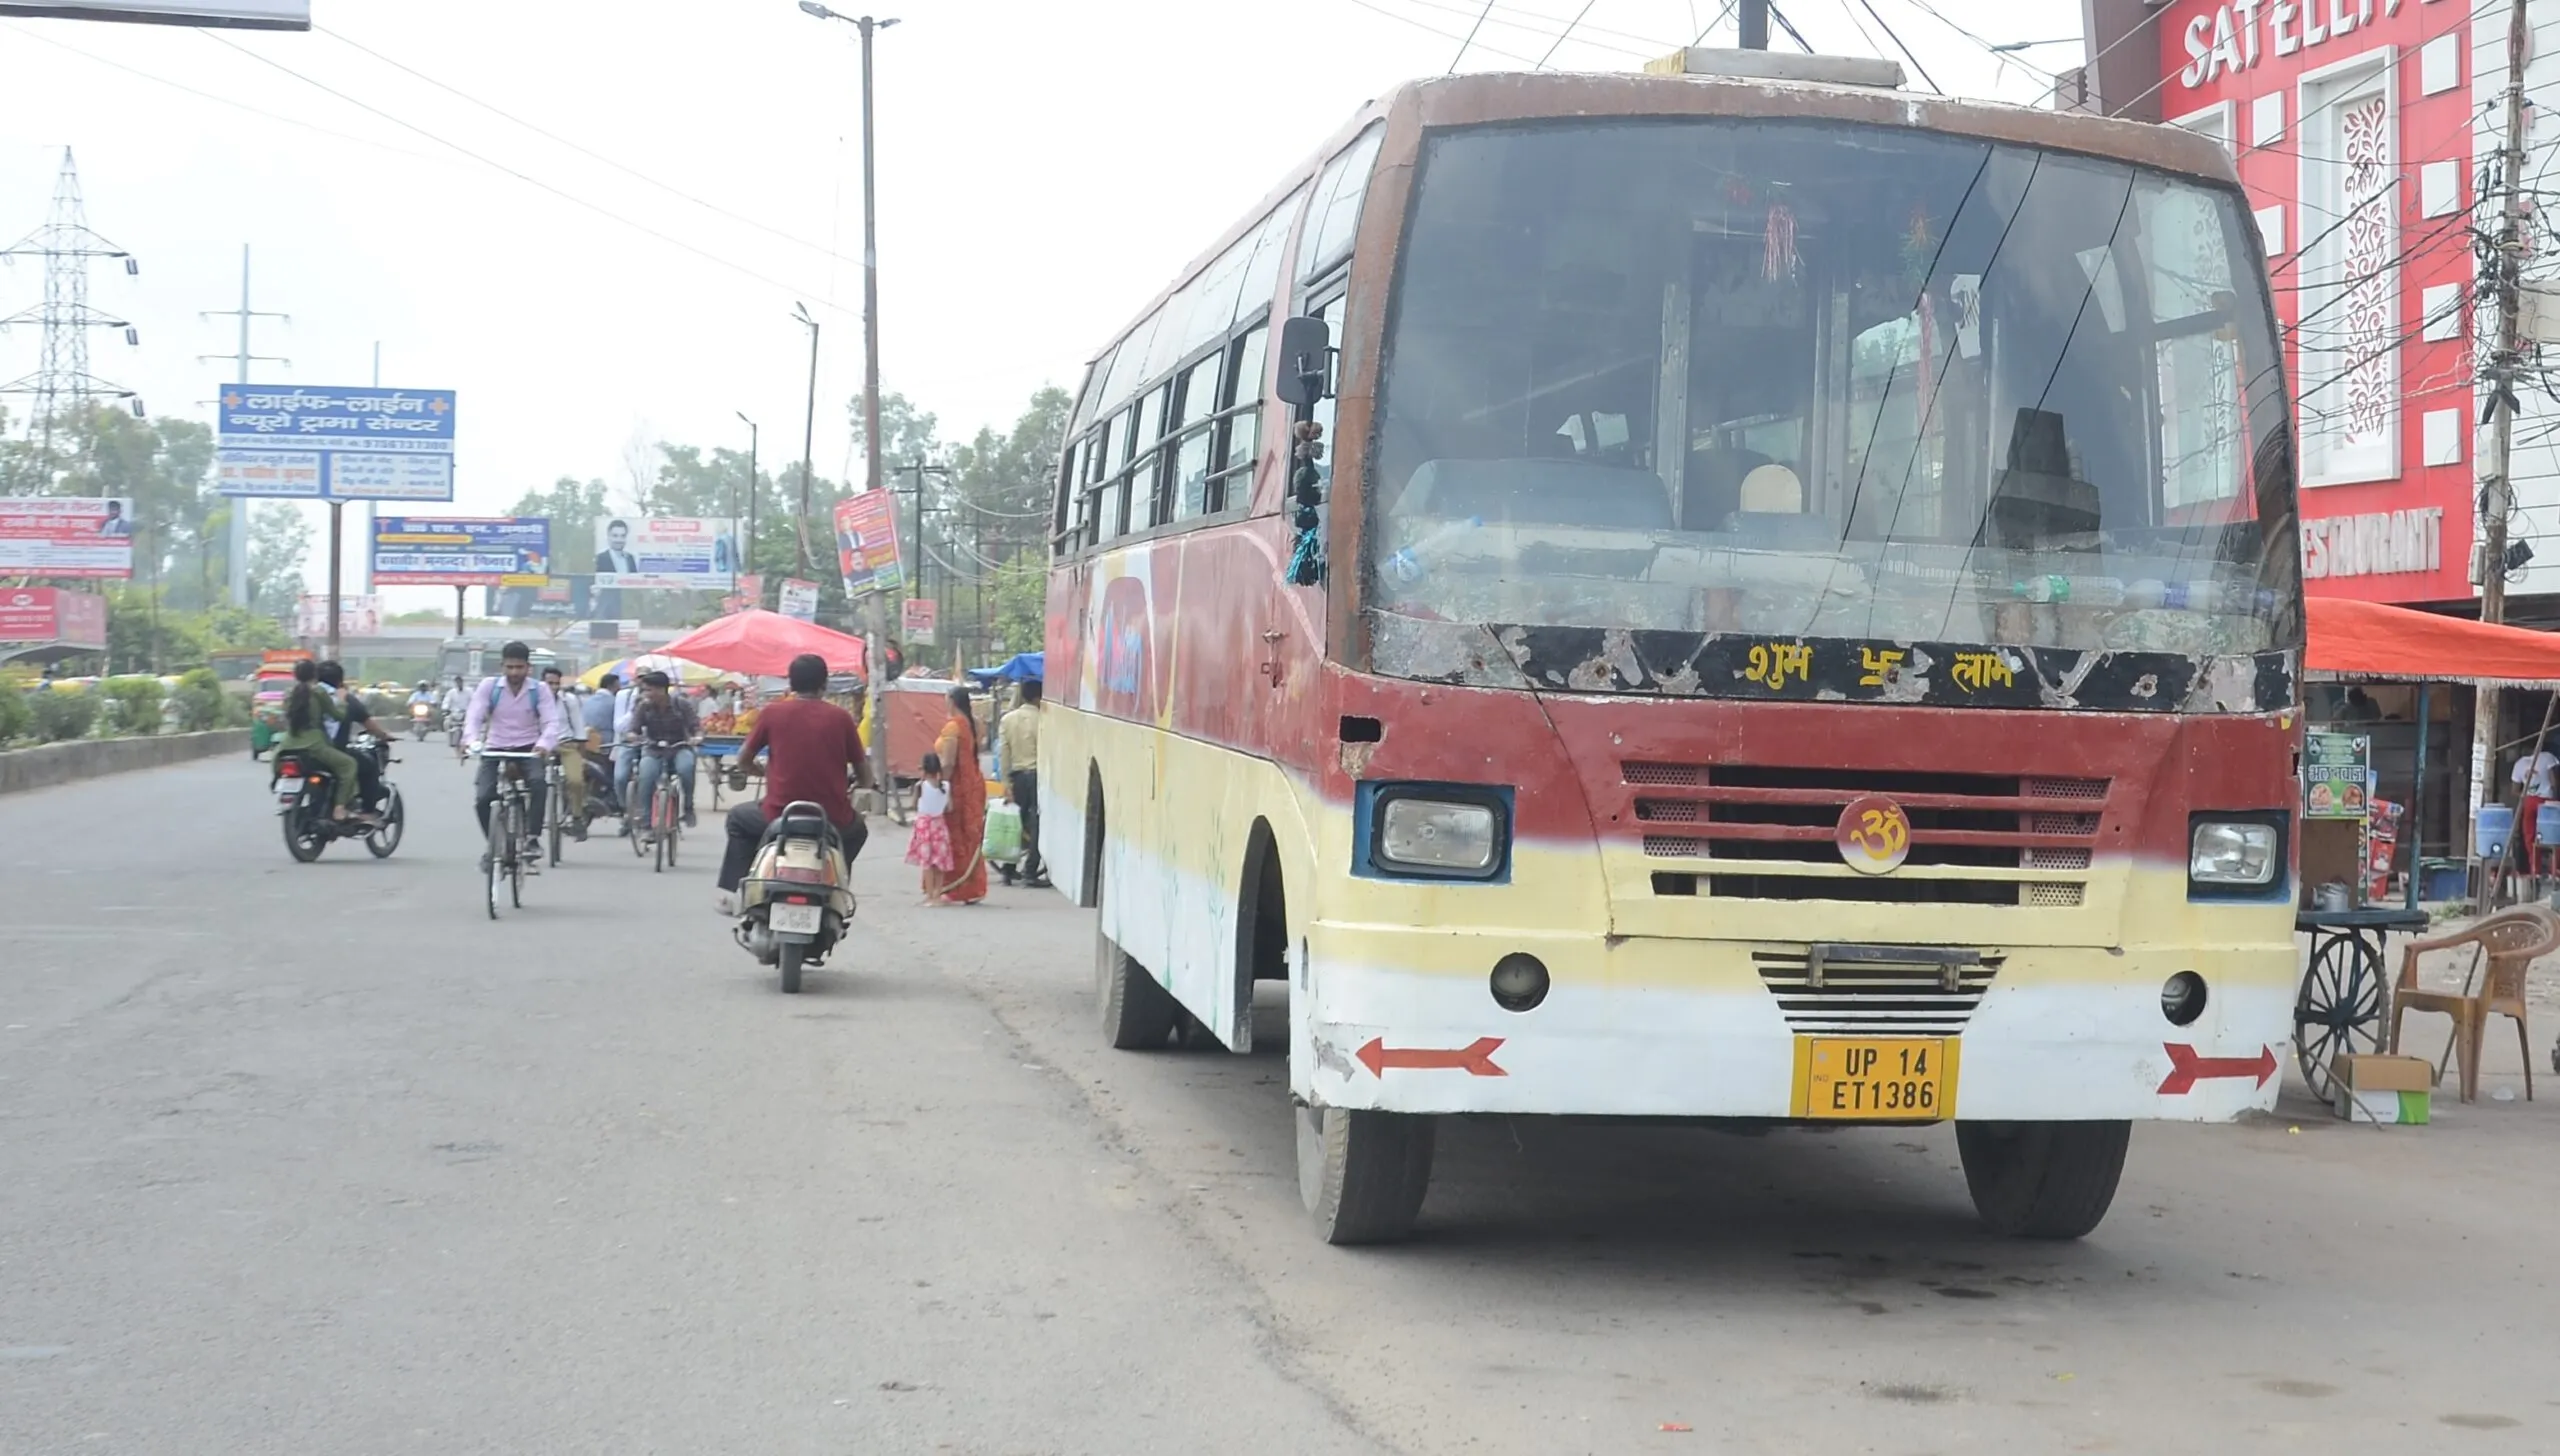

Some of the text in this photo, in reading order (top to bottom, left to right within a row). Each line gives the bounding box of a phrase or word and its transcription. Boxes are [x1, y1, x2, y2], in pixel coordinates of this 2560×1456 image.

[2181, 0, 2451, 88] SATELL
[229, 411, 293, 433] न्यूरो
[298, 415, 359, 433] ट्रामा
[2299, 506, 2443, 580] ESTAURANT
[1846, 1048, 1927, 1077] UP 14
[1833, 1080, 1934, 1110] ET1386
